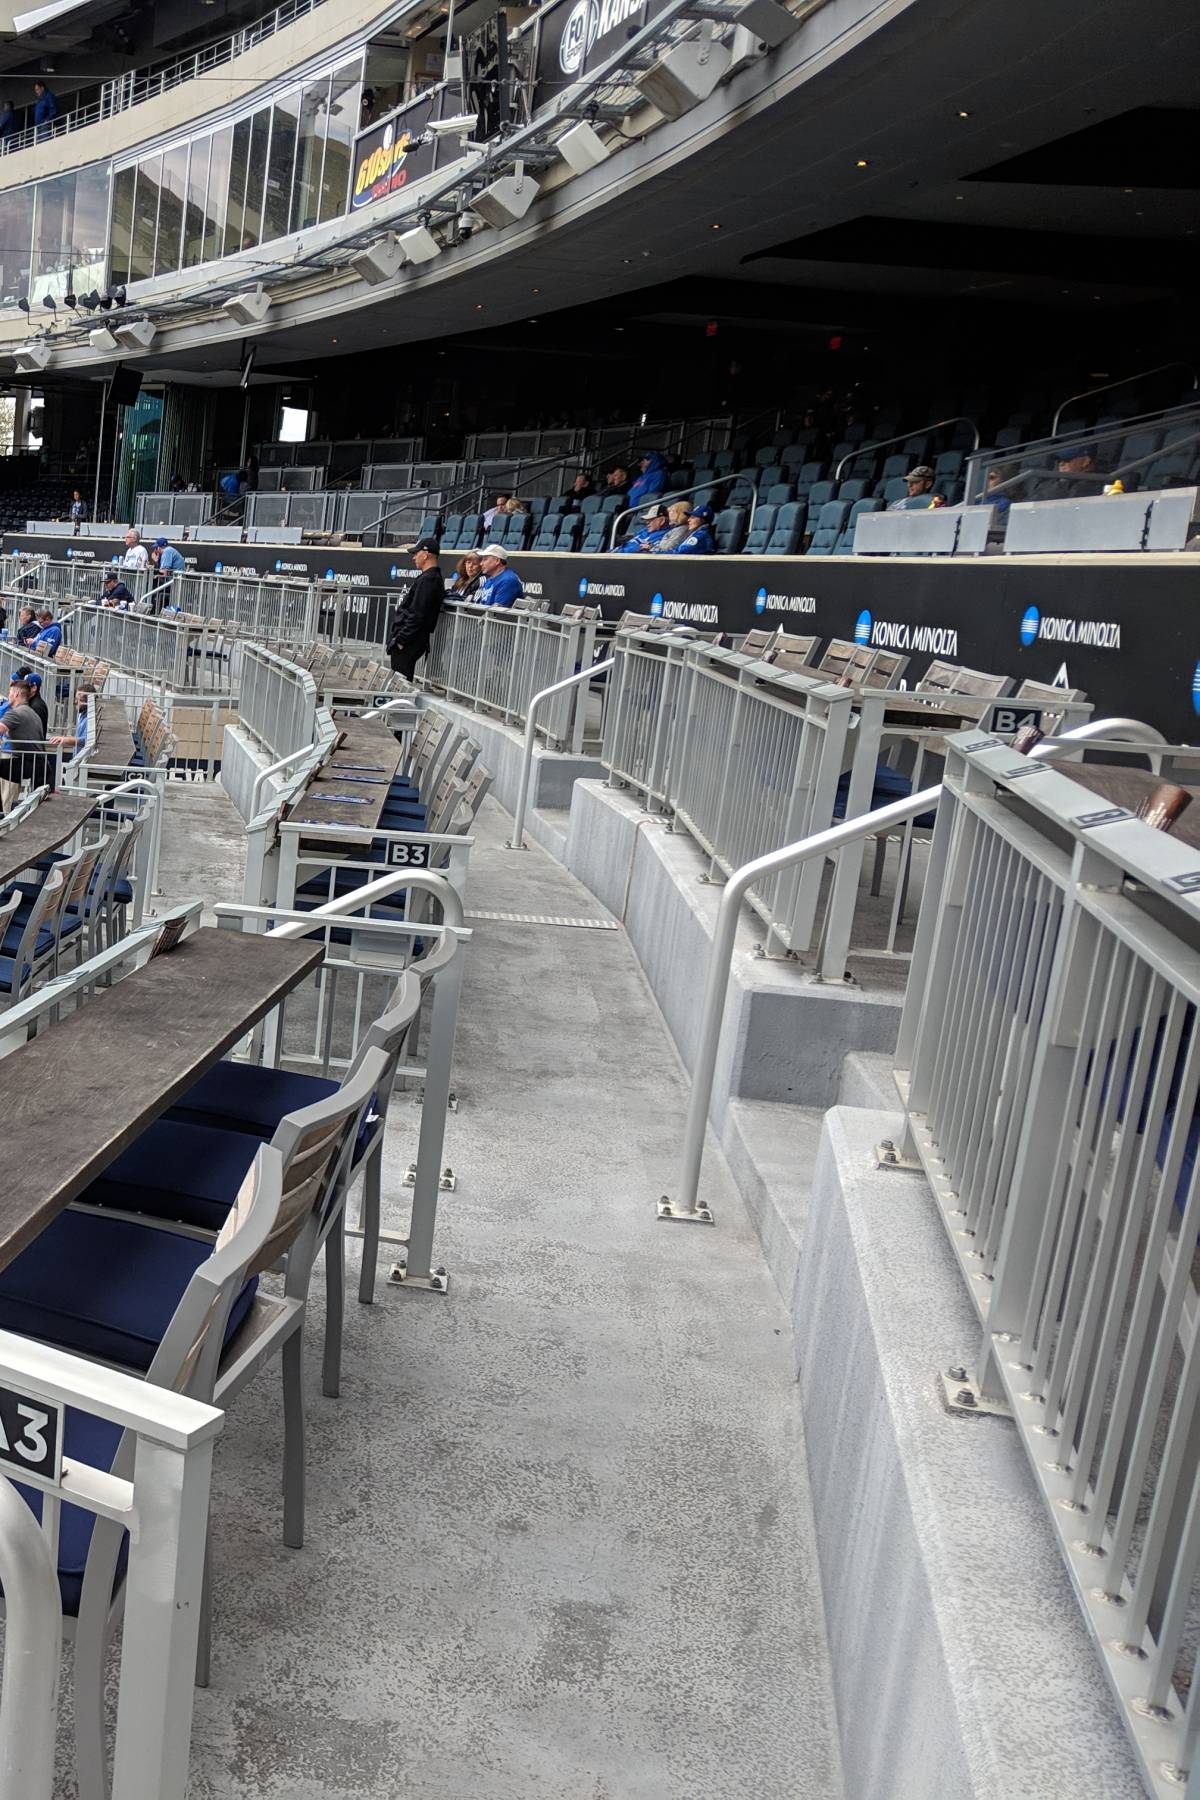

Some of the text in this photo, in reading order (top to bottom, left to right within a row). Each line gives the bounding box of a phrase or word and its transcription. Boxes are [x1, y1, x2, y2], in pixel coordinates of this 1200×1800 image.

[662, 600, 719, 624] KONICA MINOLTA
[765, 594, 816, 613] KONICA MINOLTA
[871, 621, 958, 656] KONICA MINOLTA
[1038, 616, 1120, 648] KONICA MINOLTA
[995, 710, 1036, 732] B4
[392, 844, 426, 865] B3
